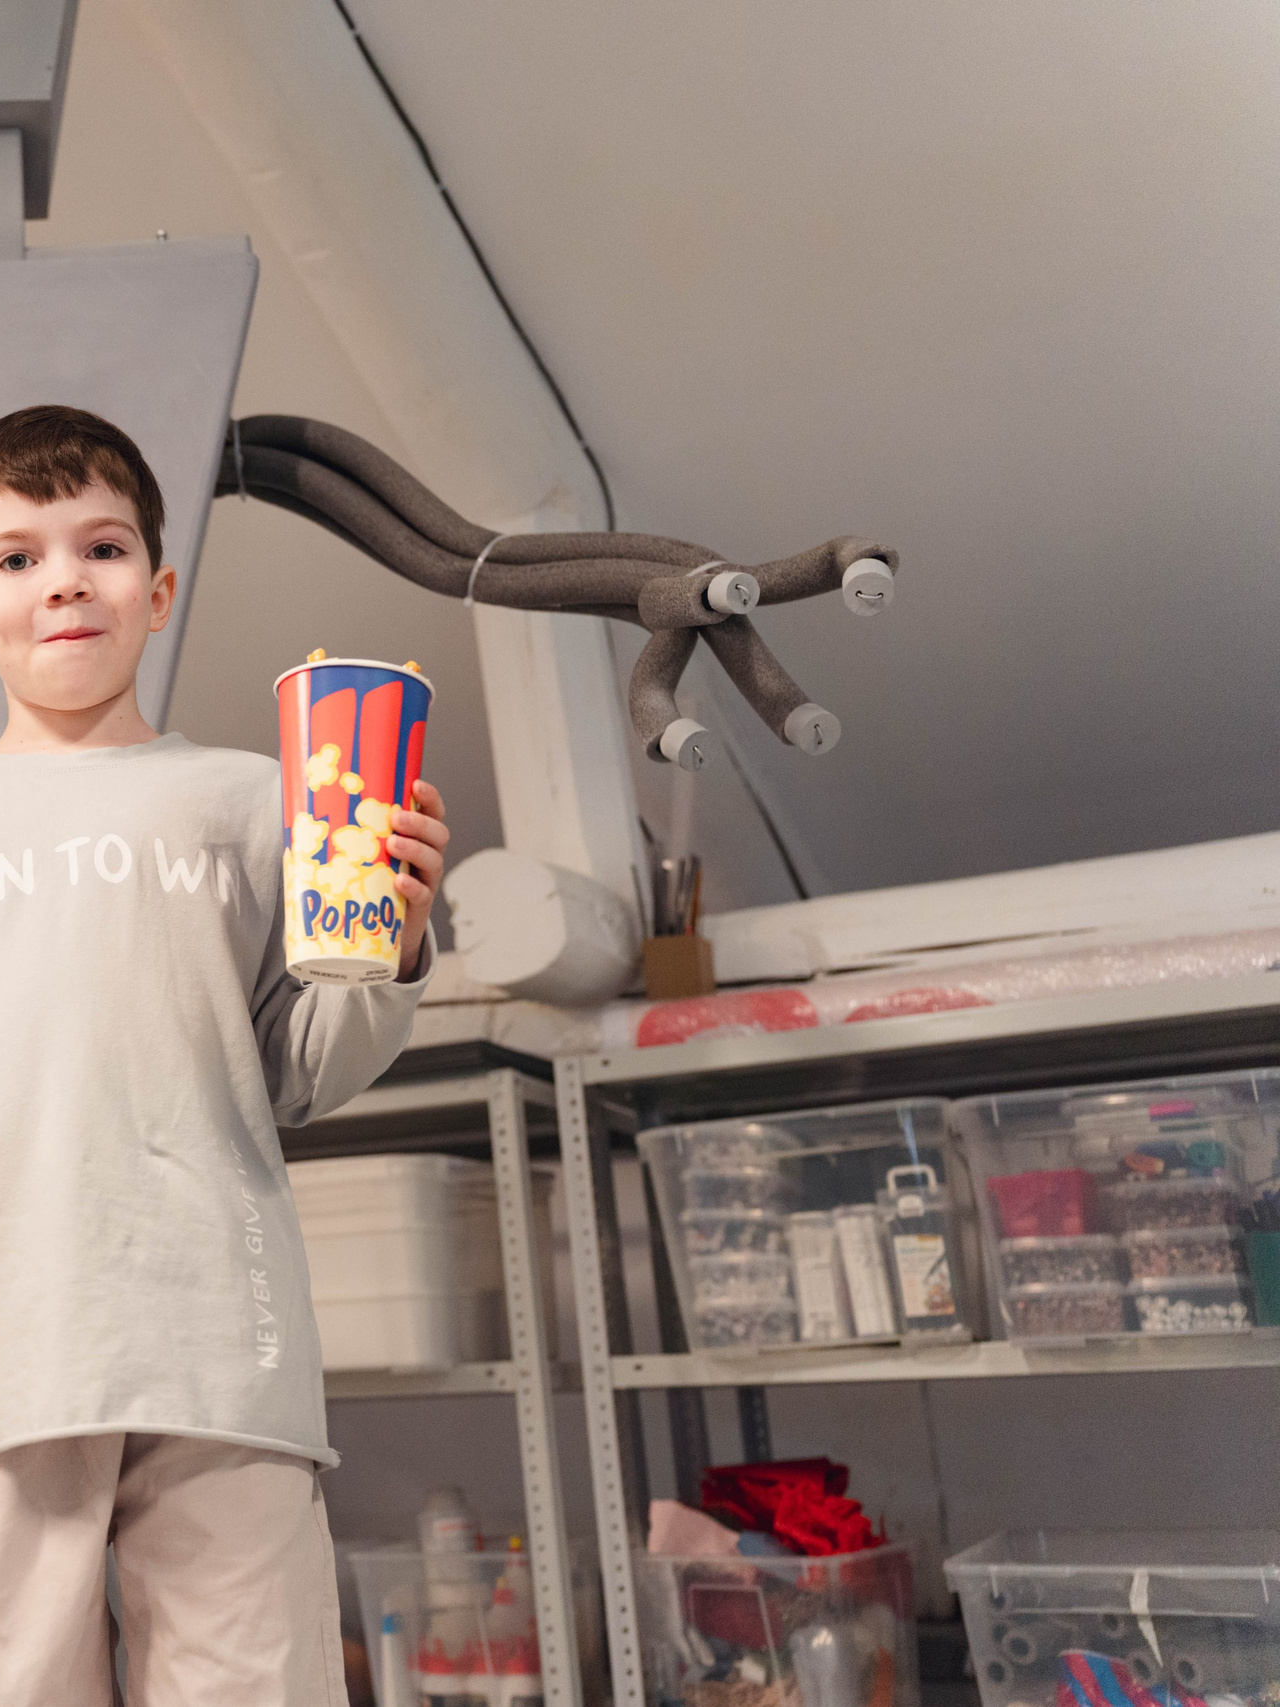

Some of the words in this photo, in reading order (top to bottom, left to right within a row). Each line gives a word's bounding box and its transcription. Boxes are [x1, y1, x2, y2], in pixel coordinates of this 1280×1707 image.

[55, 833, 132, 886] TO
[241, 1186, 264, 1255] GIVE
[250, 1268, 279, 1369] NEVER
